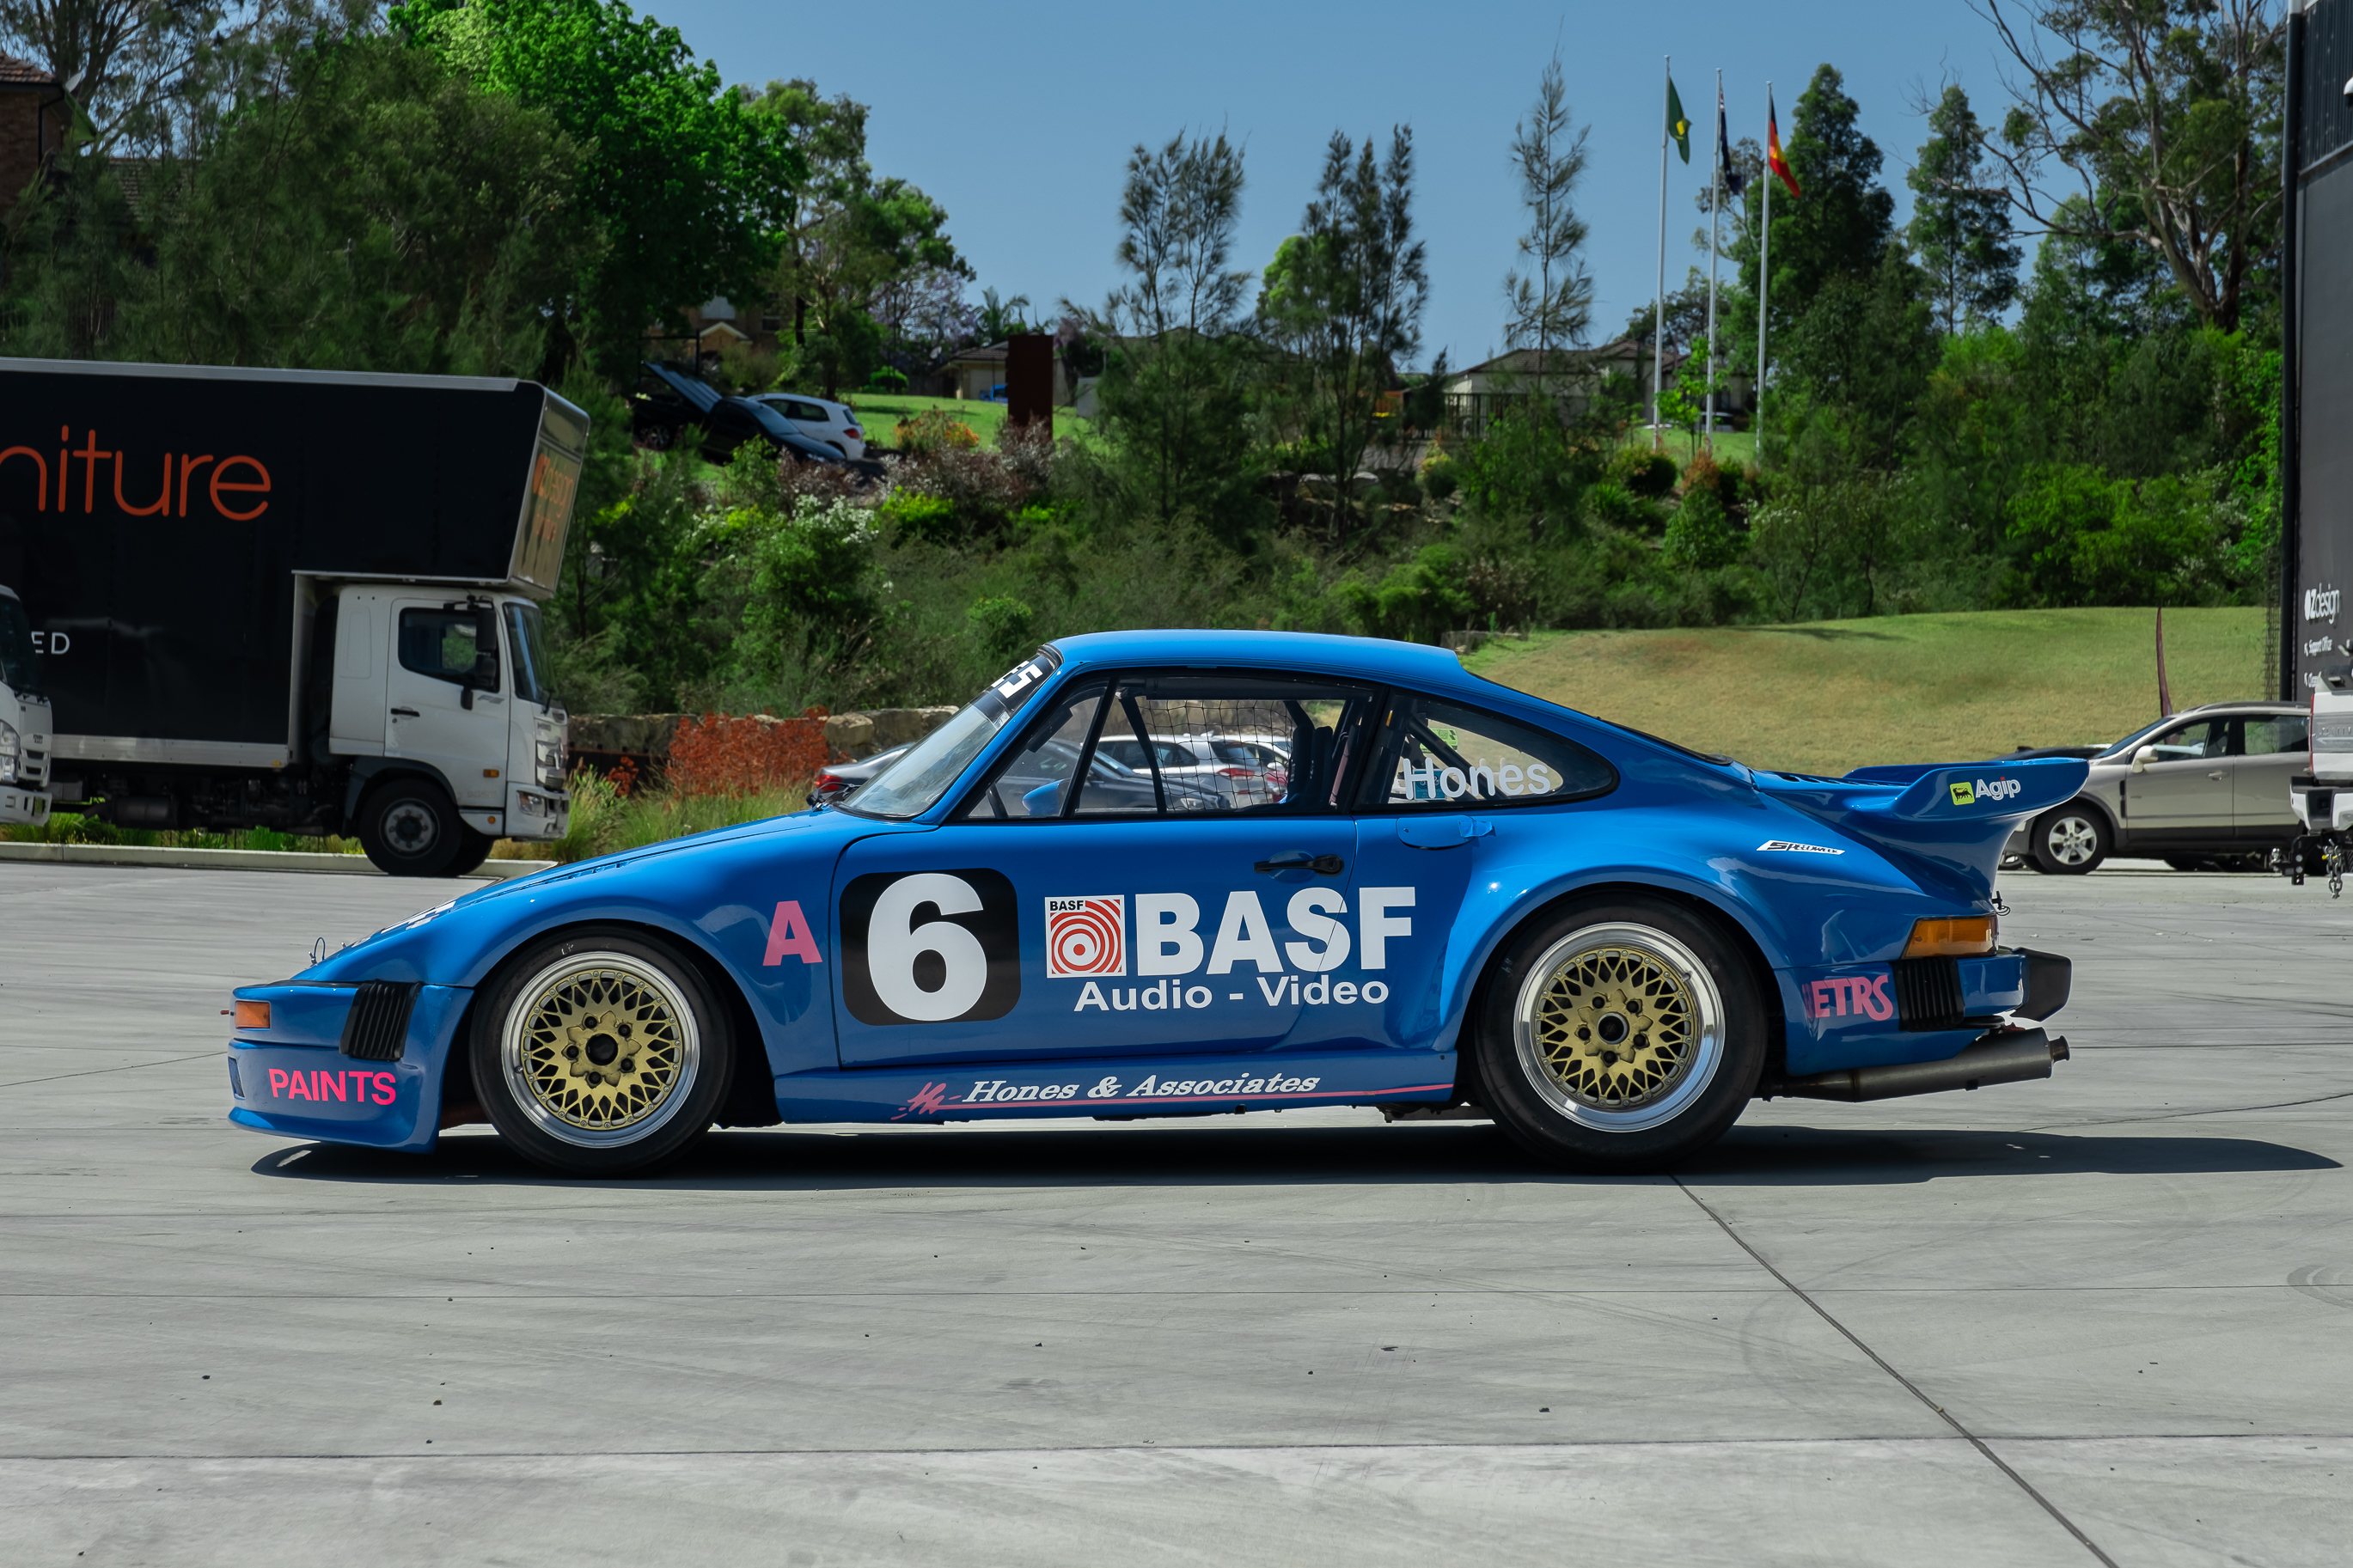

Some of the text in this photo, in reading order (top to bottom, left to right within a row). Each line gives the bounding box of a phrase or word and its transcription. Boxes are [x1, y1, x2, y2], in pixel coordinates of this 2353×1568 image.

[0, 424, 271, 521] niture
[1403, 757, 1551, 800] Hones
[1975, 776, 2021, 801] Agip
[1049, 900, 1085, 912] BASF
[762, 900, 823, 966] A
[867, 873, 987, 1022] 6
[1134, 886, 1416, 976] BASF
[1073, 979, 1213, 1012] Audio
[1256, 974, 1390, 1006] Video
[268, 1068, 397, 1106] PAINTS
[962, 1072, 1321, 1102] Hones & Associates
